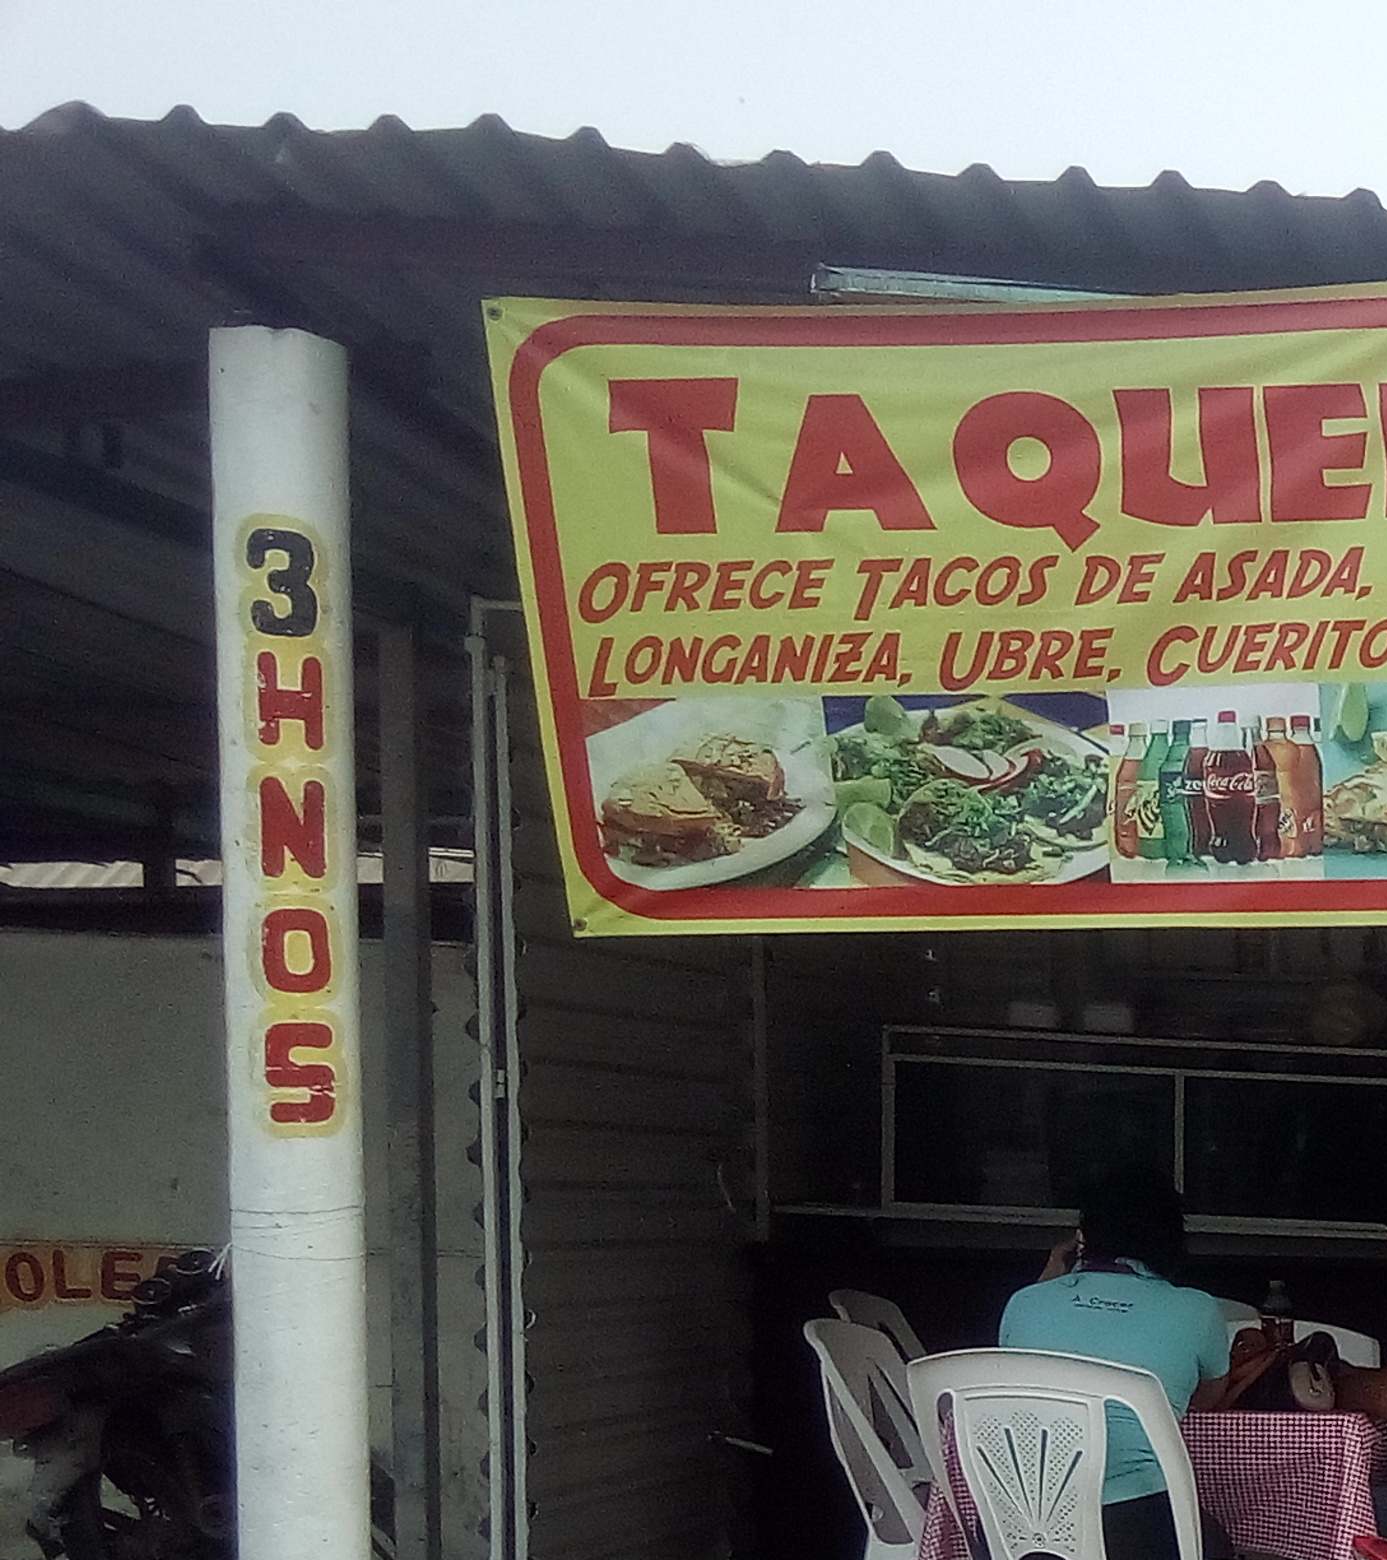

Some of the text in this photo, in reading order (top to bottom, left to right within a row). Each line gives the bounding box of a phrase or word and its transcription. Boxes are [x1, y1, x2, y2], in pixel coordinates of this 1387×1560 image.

[578, 559, 834, 623] OFRECE
[854, 555, 1059, 620] TACOS
[1075, 552, 1165, 606] DE
[1174, 547, 1371, 603] ASADA,
[589, 631, 912, 697] LONGANIZA,
[939, 629, 1121, 691] UBRE,
